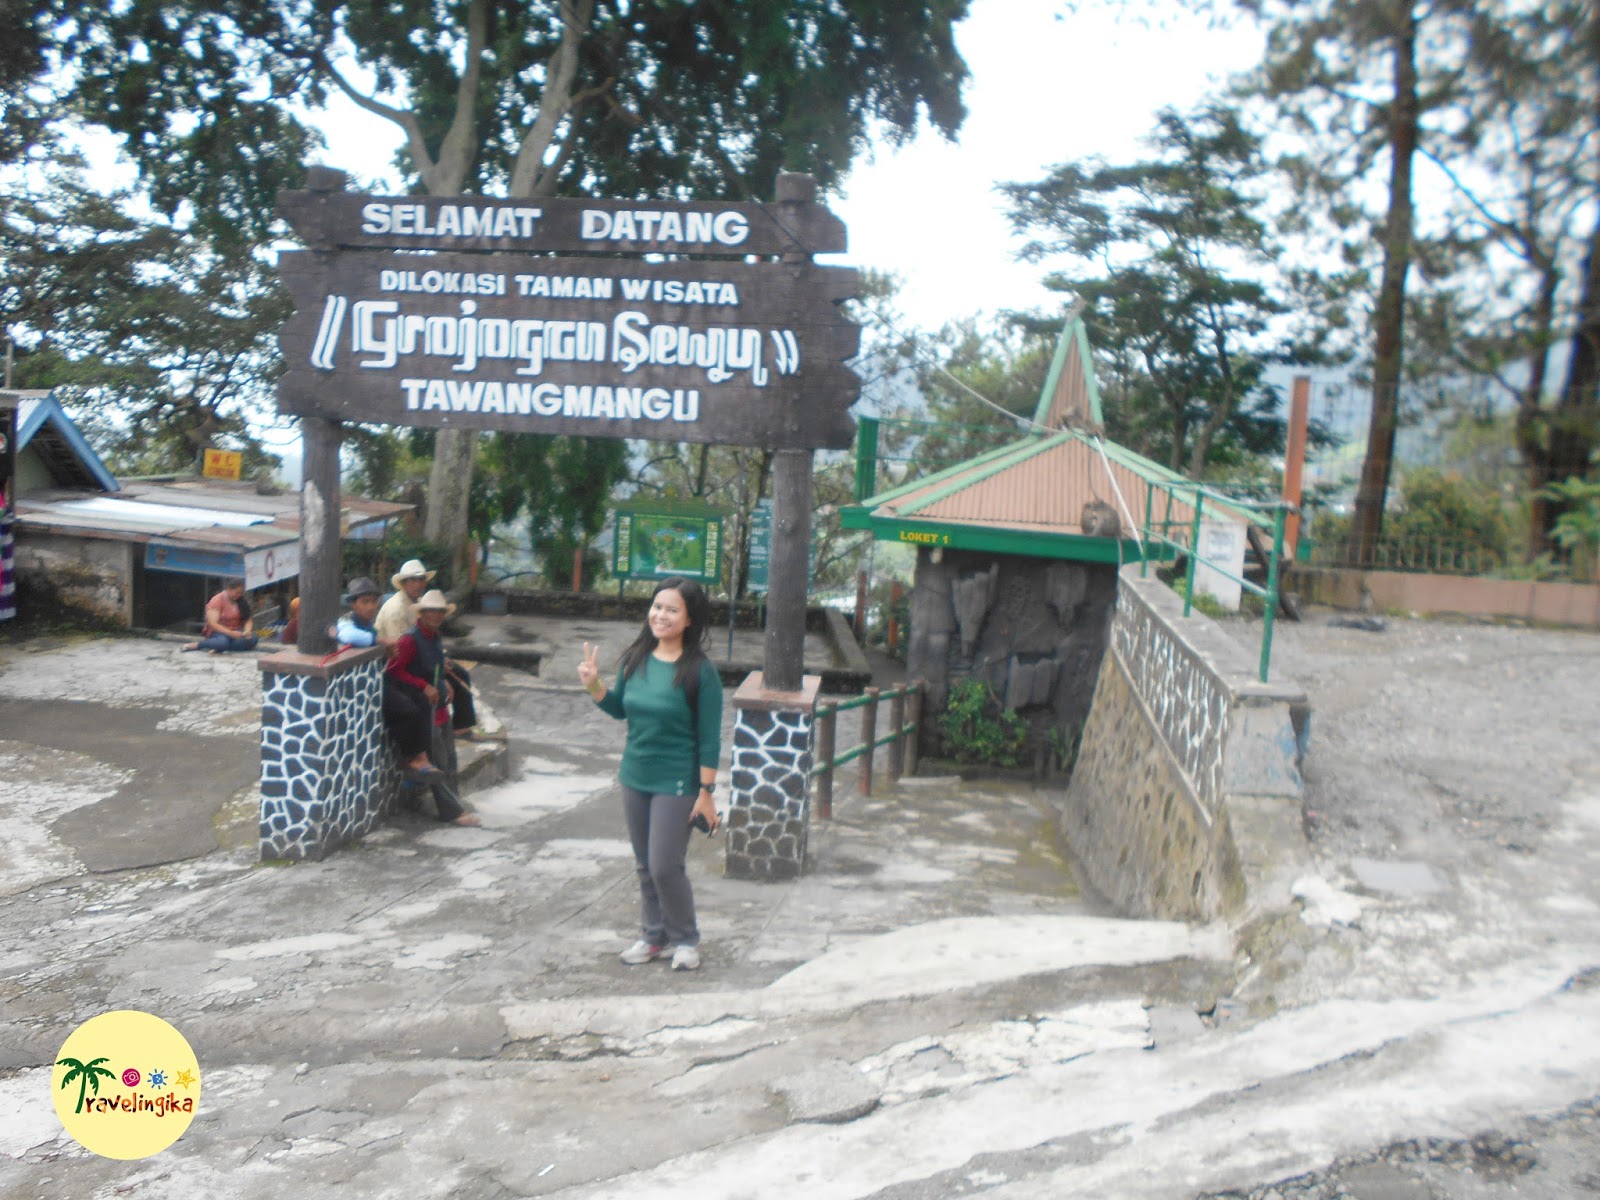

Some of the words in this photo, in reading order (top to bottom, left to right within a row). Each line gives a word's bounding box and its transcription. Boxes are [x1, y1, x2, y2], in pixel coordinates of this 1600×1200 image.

[362, 203, 541, 238] SELAMAT
[582, 209, 750, 245] DATANG
[379, 270, 506, 295] DILOKASI
[514, 274, 612, 299] TAMAN
[621, 278, 739, 305] WISATA
[400, 378, 699, 422] TAWANGMANGU
[900, 530, 939, 544] LOKET
[942, 535, 950, 545] 1
